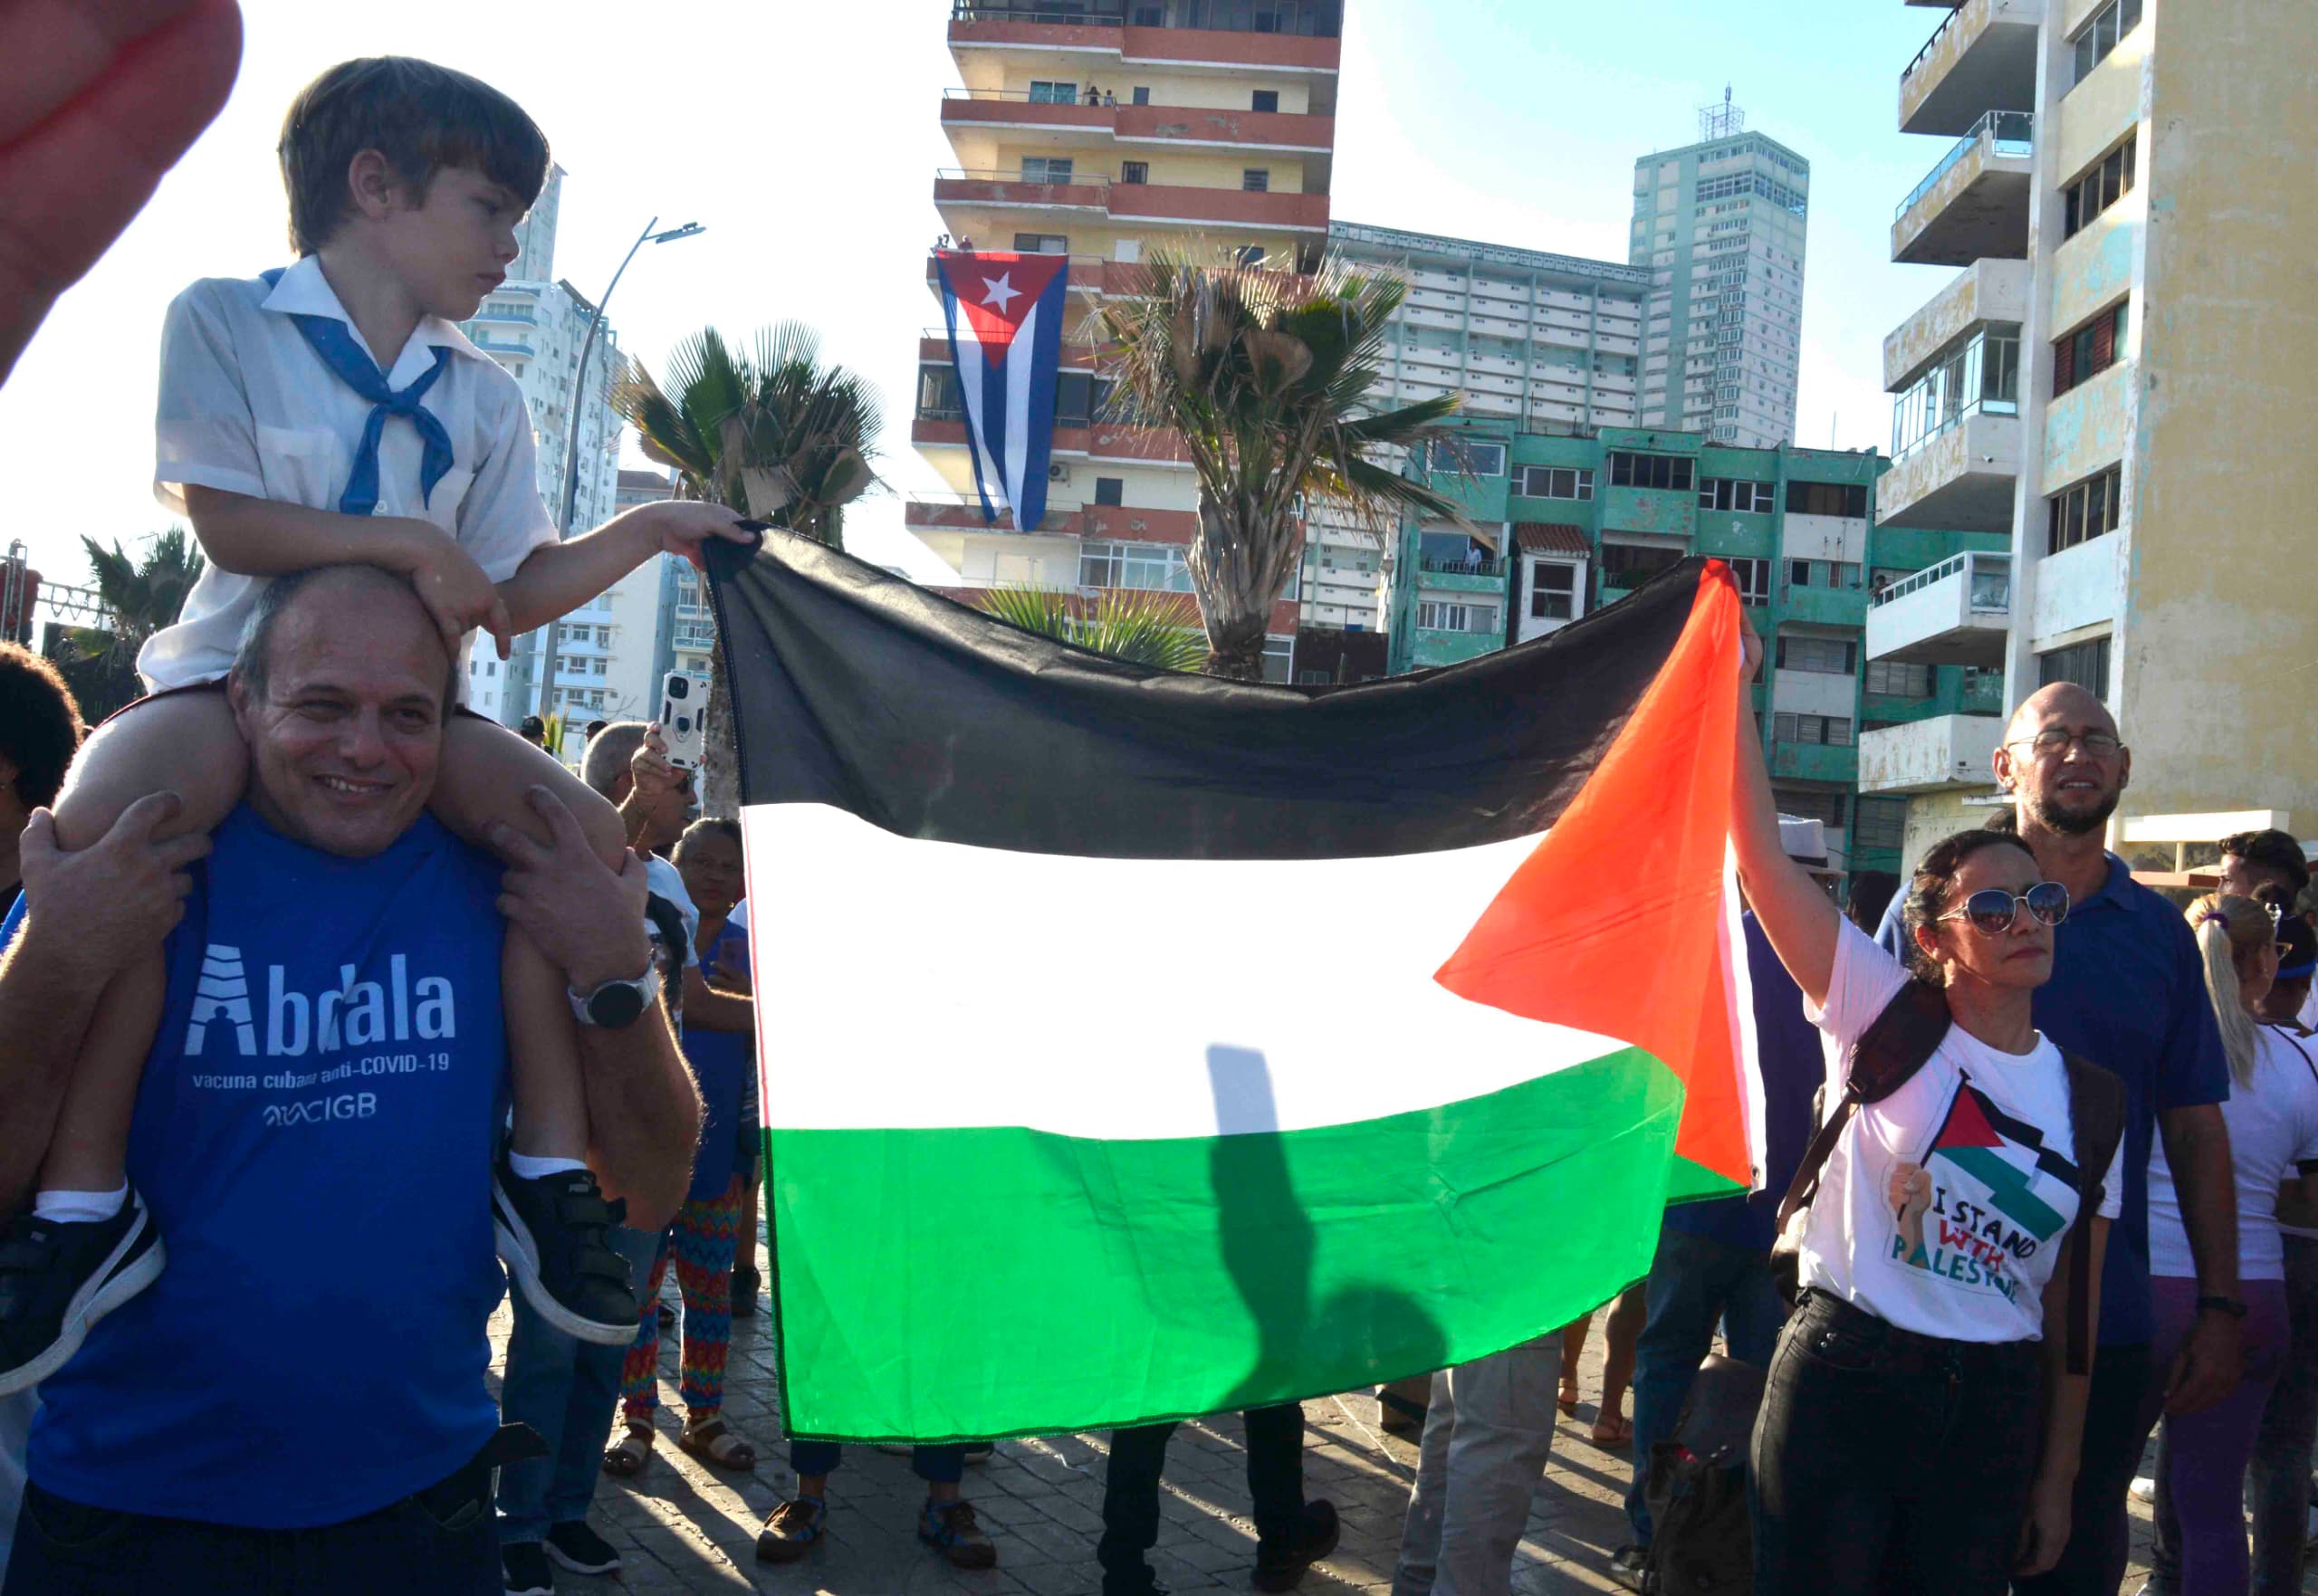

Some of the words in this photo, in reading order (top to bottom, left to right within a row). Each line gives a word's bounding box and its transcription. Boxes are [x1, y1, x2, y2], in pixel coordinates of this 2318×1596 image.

[193, 1075, 257, 1089] vacuna
[321, 1053, 449, 1084] anti-COVID-19
[1933, 1186, 1946, 1215] I
[1951, 1200, 2036, 1259] STAND
